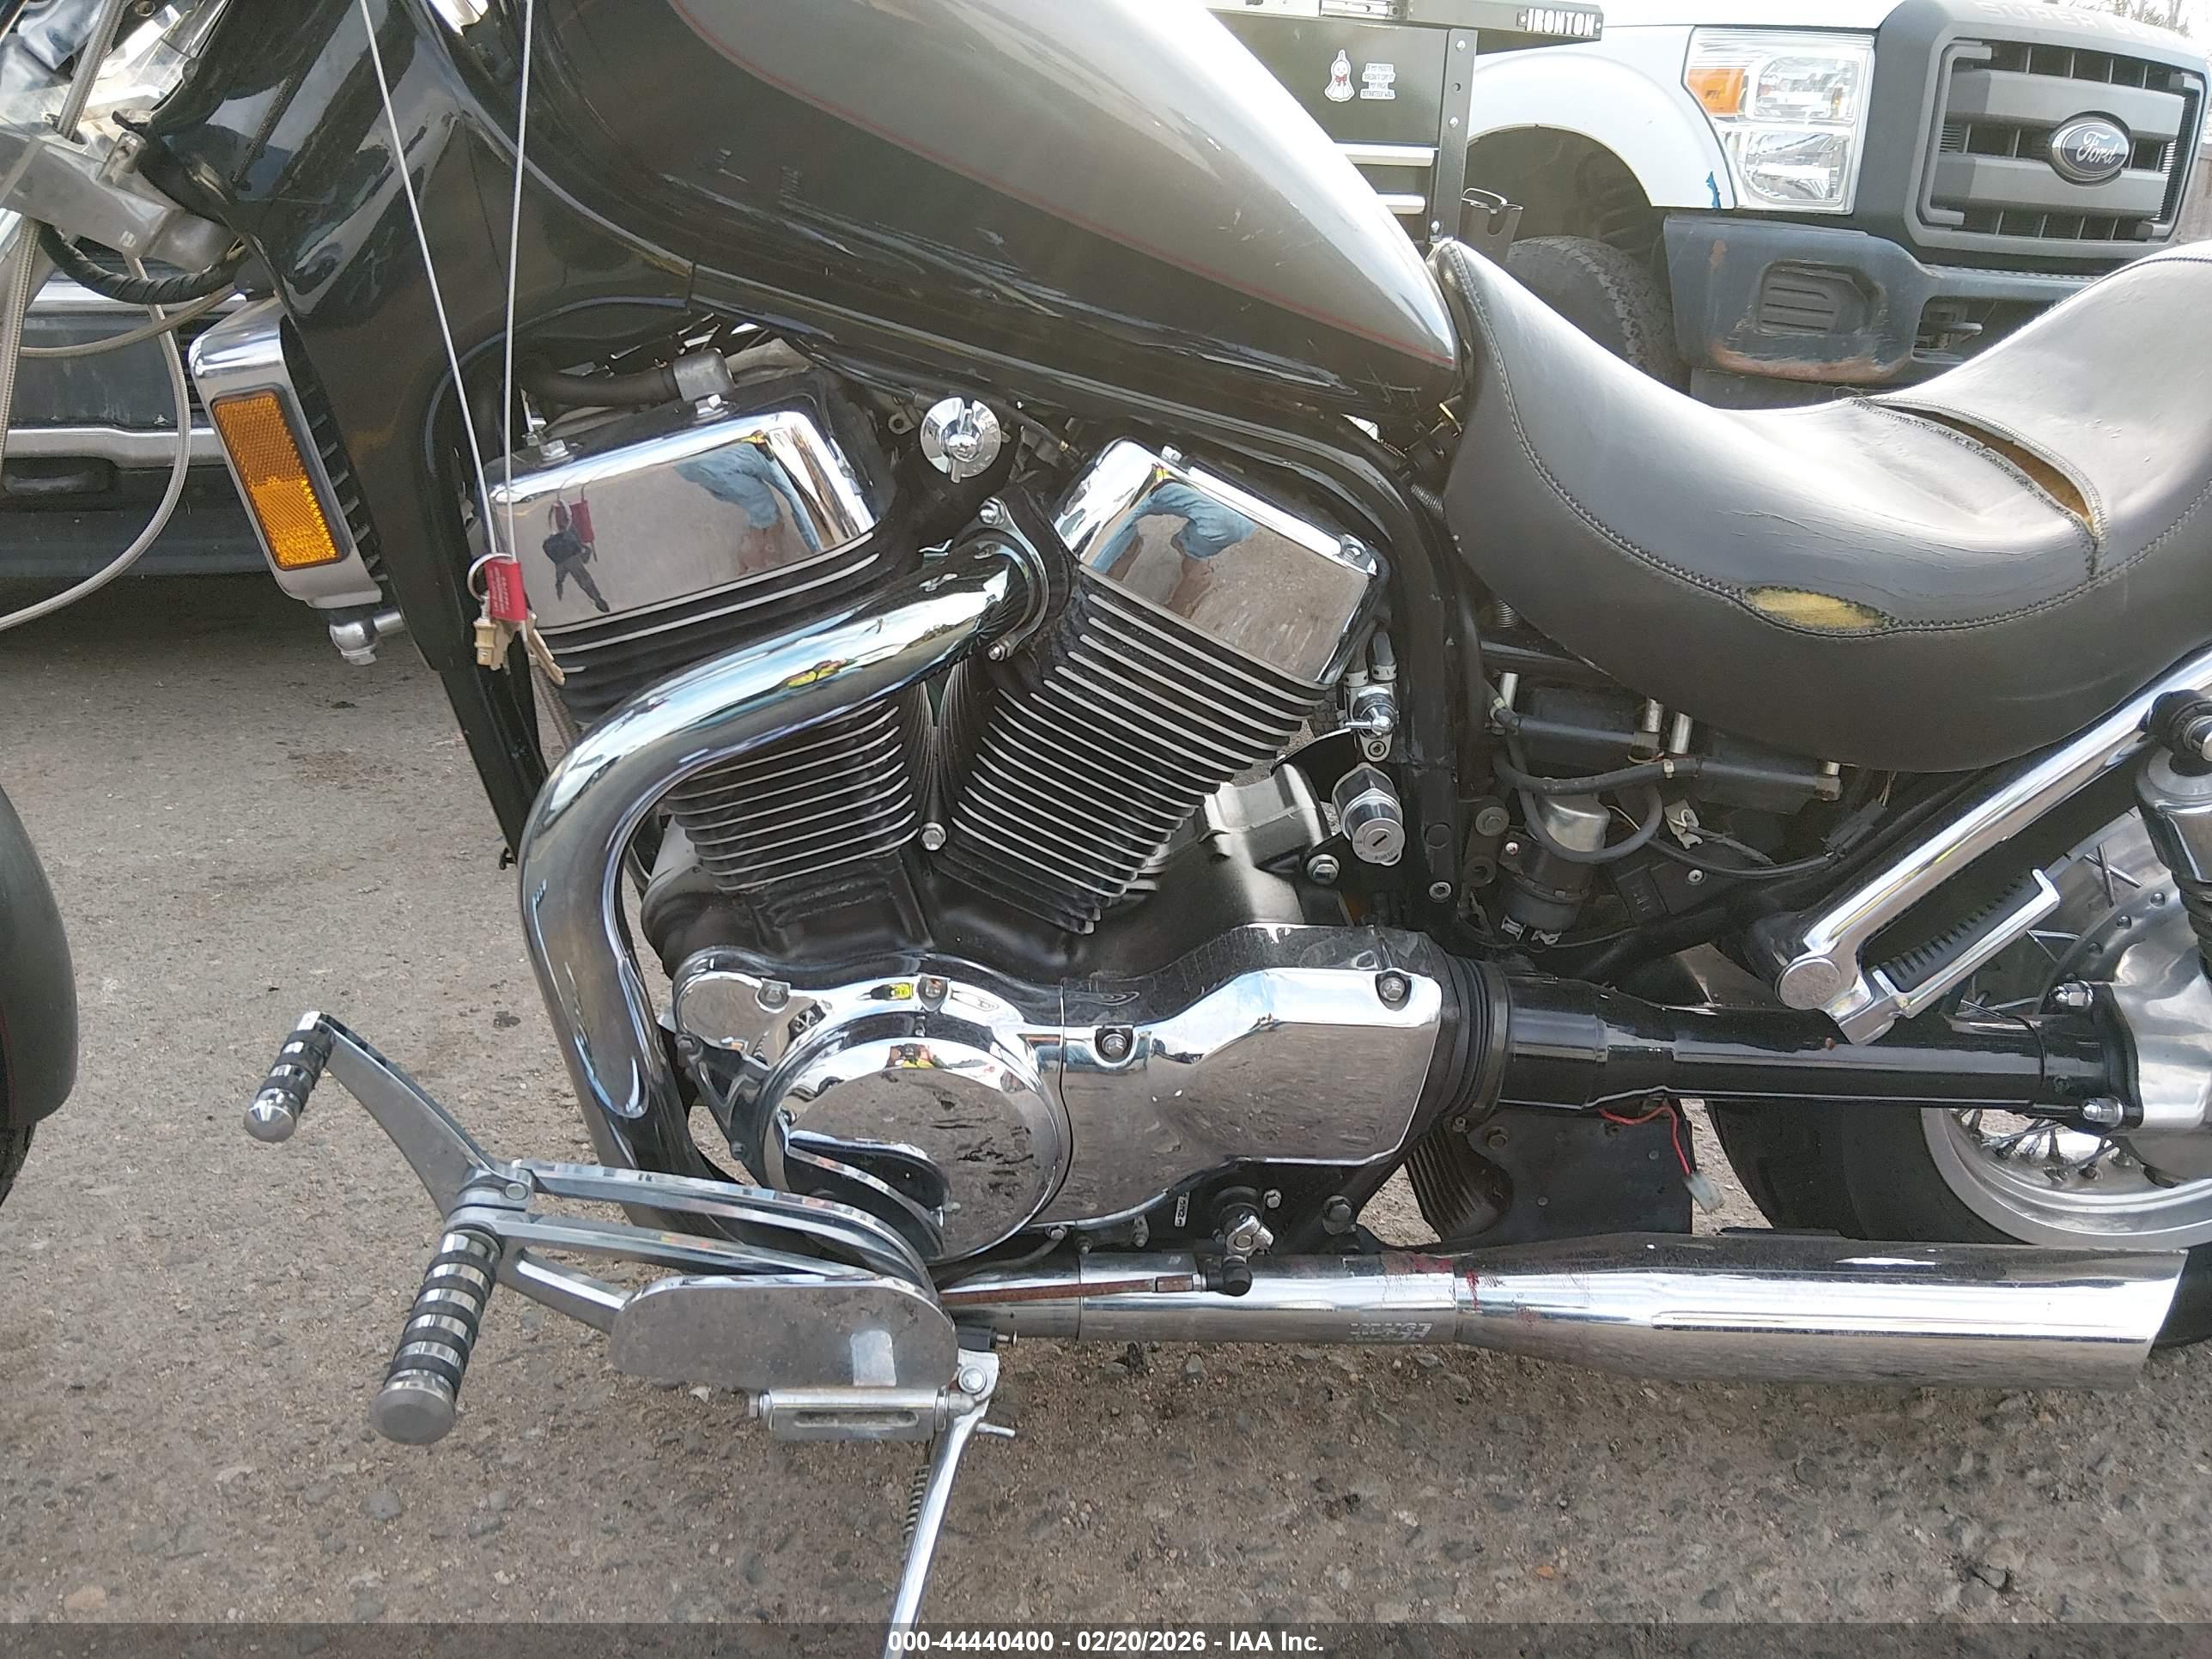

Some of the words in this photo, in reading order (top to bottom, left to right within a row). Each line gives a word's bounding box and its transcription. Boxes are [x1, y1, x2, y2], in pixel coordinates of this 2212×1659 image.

[1527, 8, 1595, 36] IRONTON
[1974, 1, 2100, 29] SUPER
[2076, 131, 2119, 164] Ford
